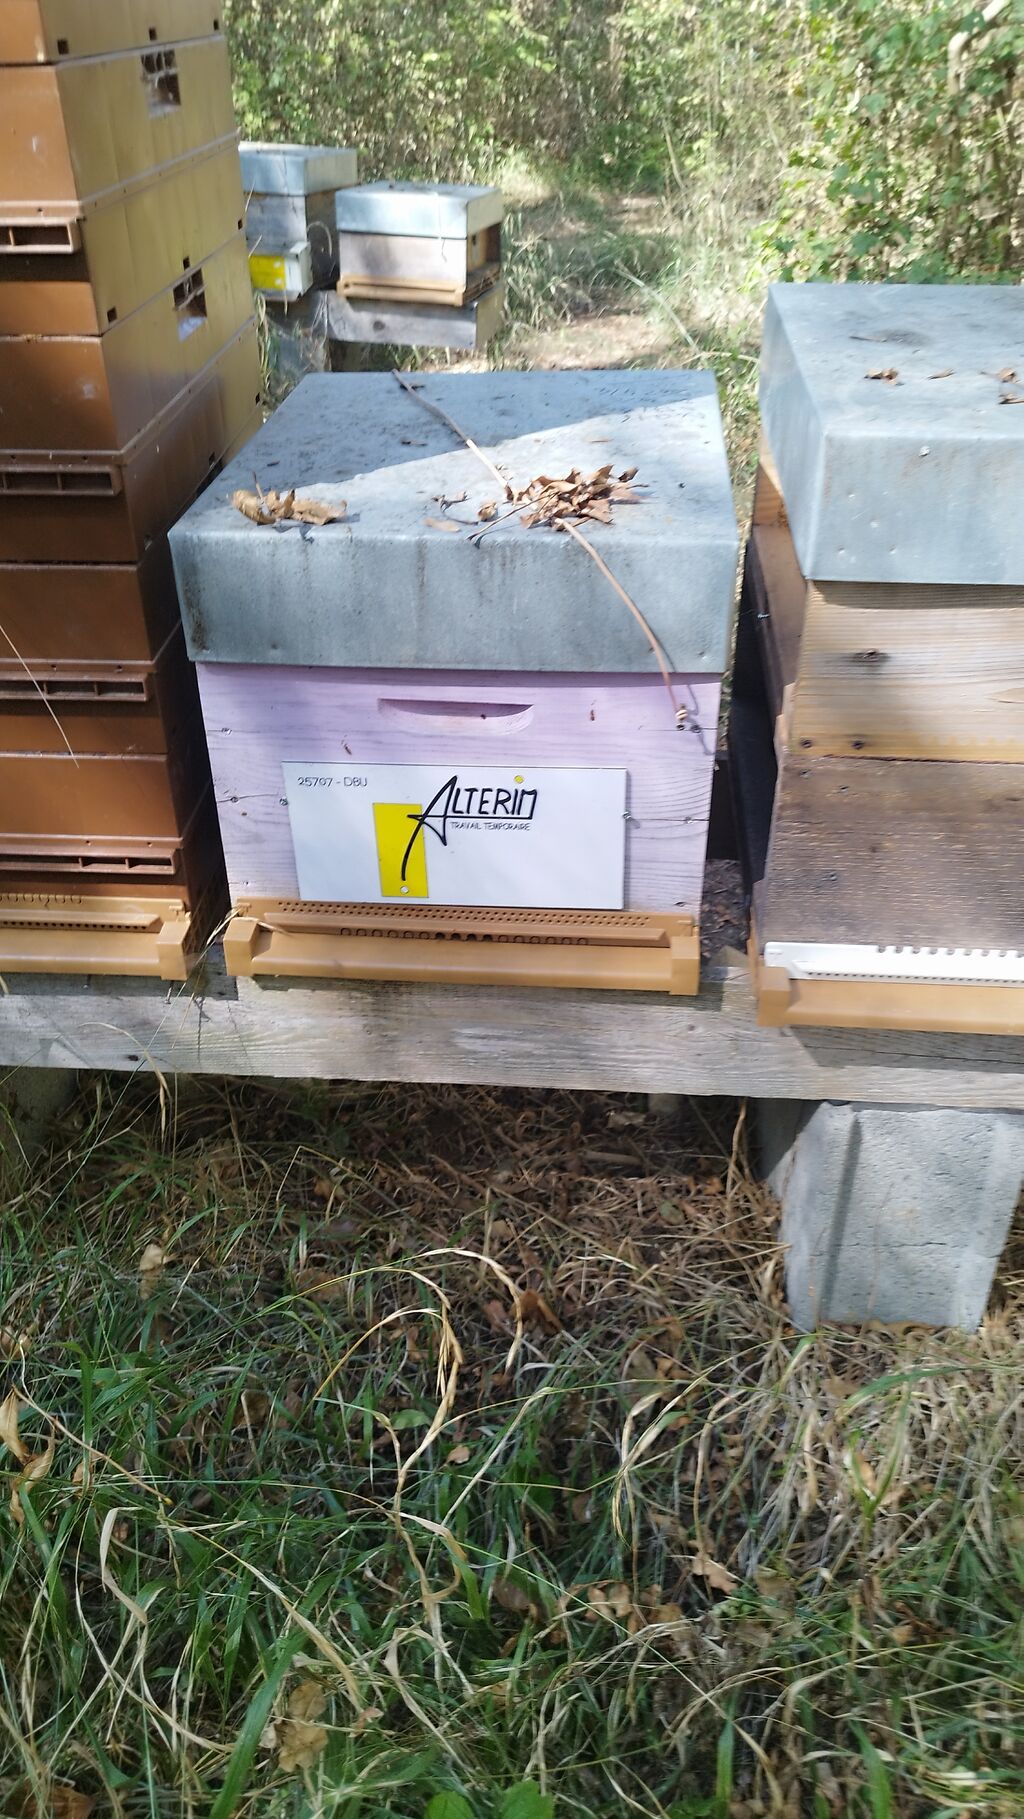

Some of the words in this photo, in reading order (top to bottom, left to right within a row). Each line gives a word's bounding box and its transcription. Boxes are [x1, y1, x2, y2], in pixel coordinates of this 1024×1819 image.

[401, 775, 538, 881] ALTERIM
[450, 821, 482, 830] TRAVAIL
[483, 821, 532, 831] TEMPORAIRE
